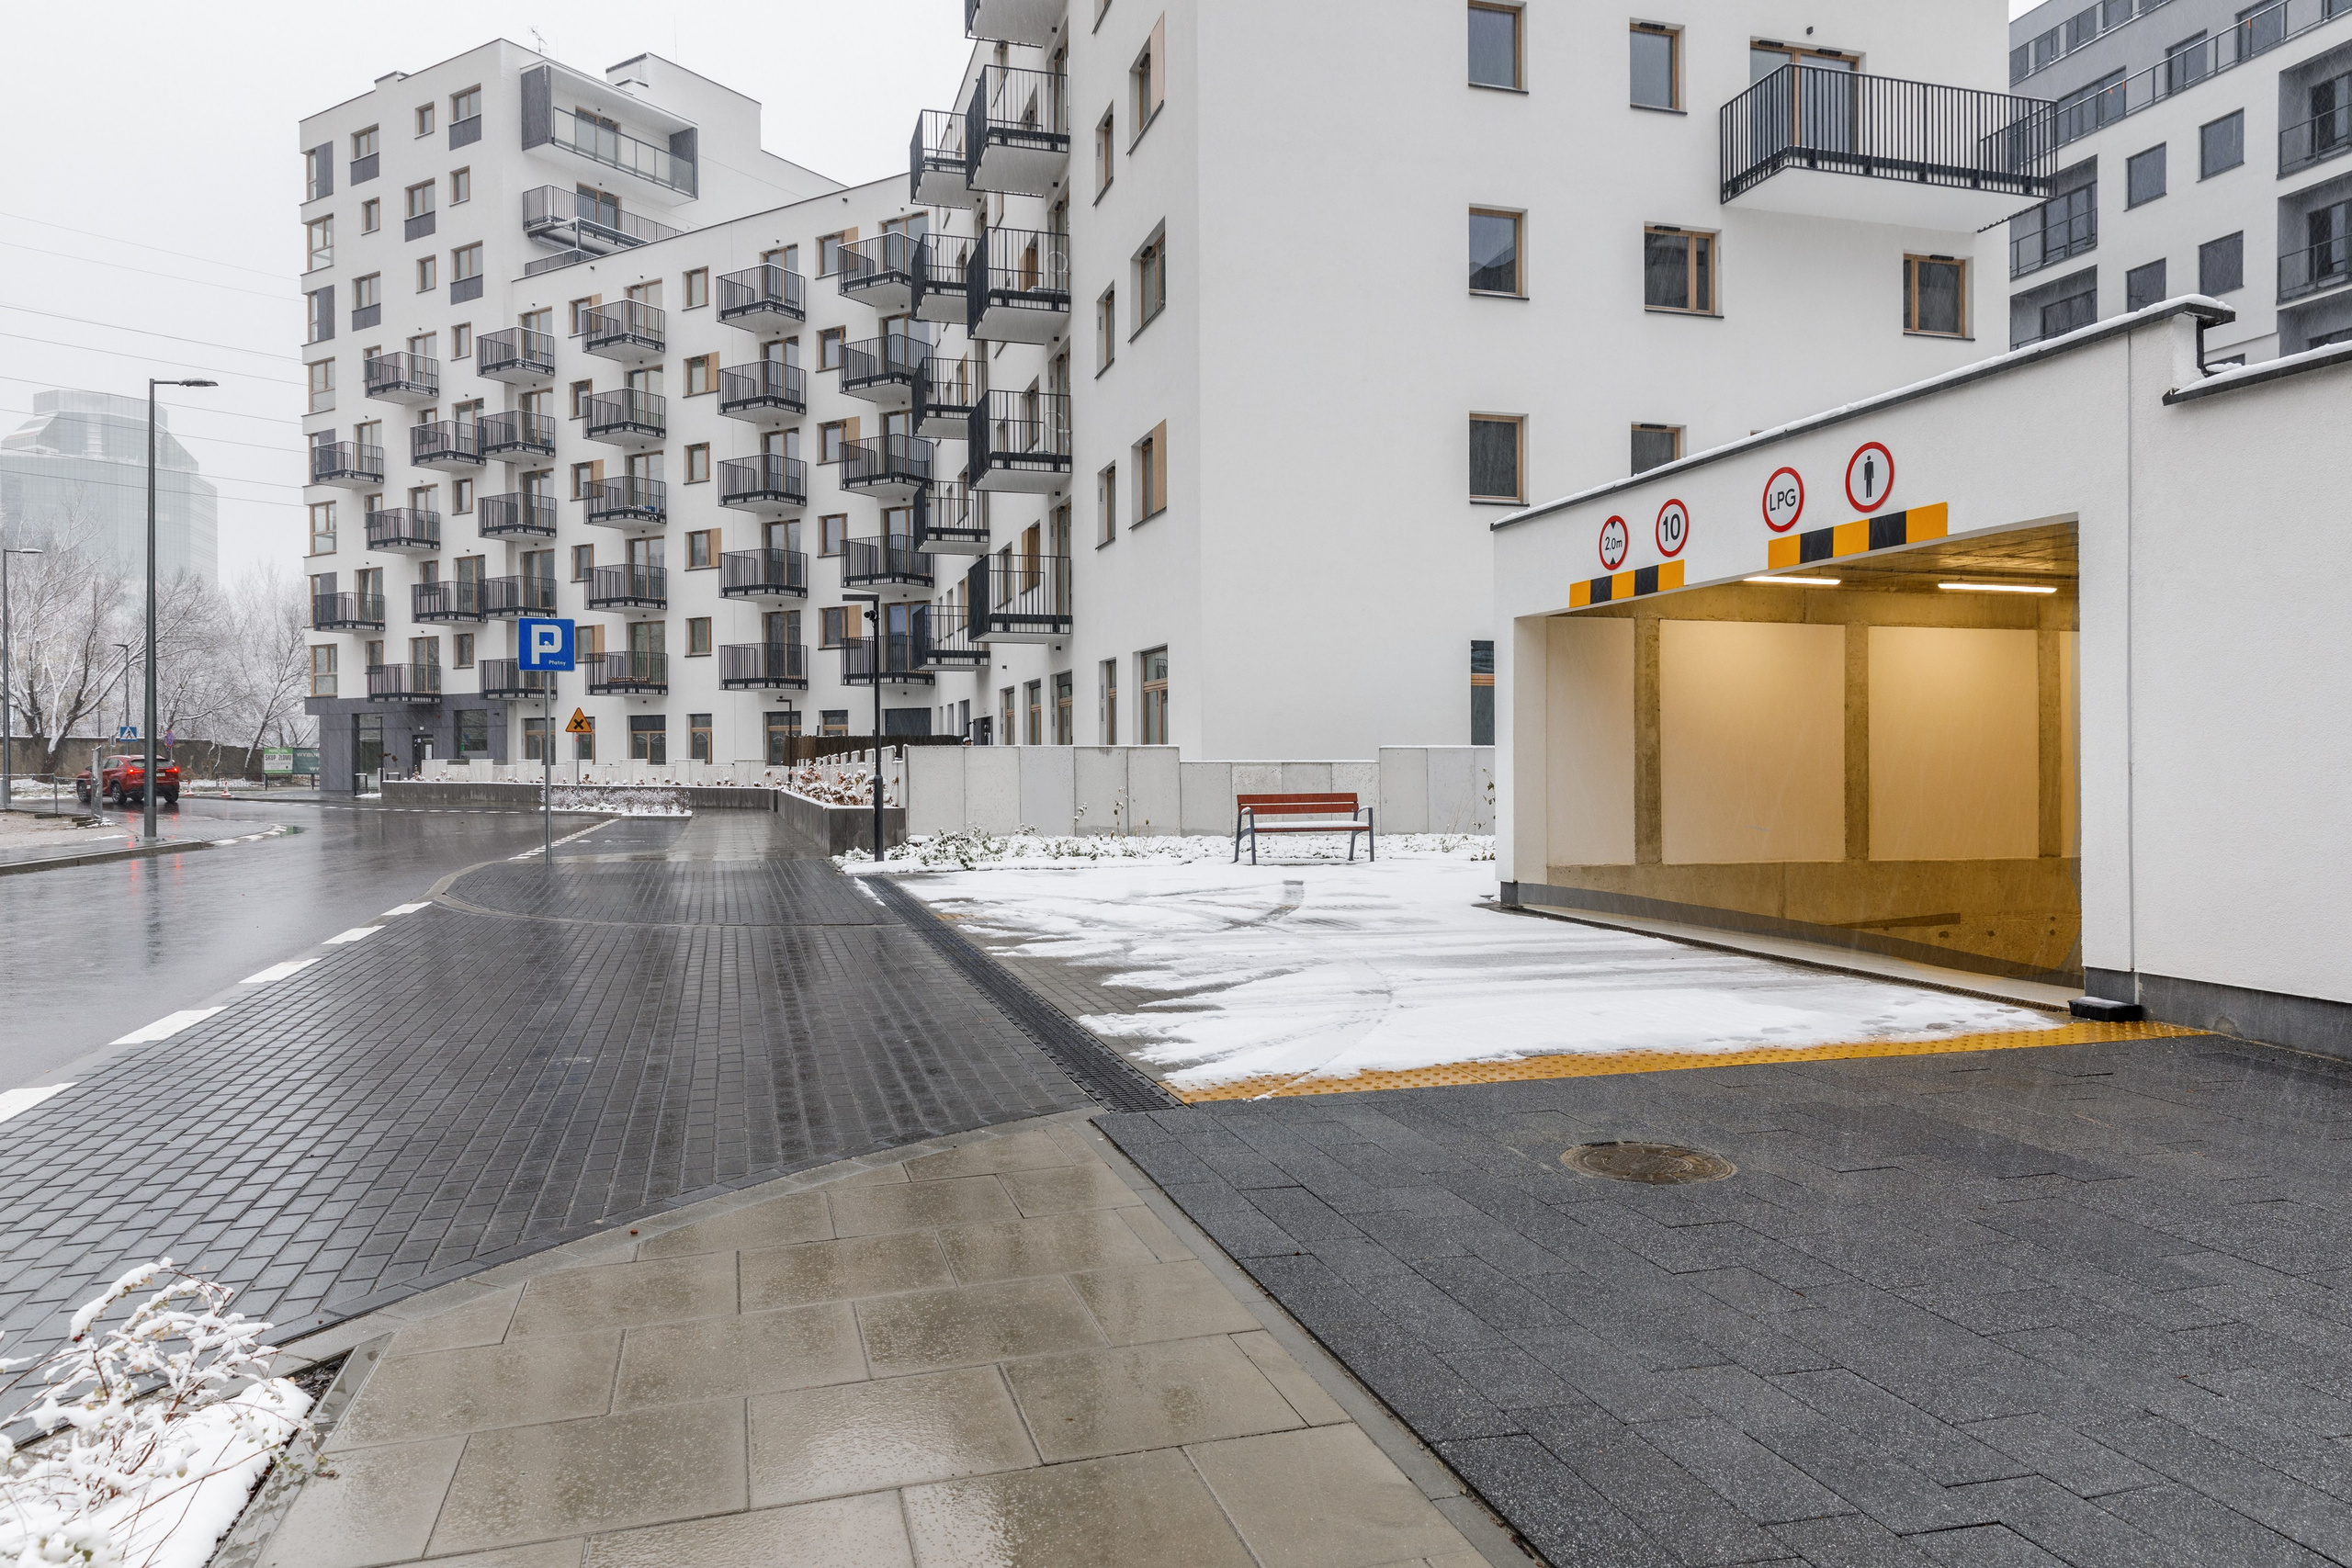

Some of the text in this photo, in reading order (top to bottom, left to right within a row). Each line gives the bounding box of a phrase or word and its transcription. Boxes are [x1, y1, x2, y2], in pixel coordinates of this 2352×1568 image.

[1770, 488, 1796, 512] LPG
[1662, 513, 1680, 542] 10
[1604, 536, 1623, 551] 2,0m
[531, 624, 562, 665] P
